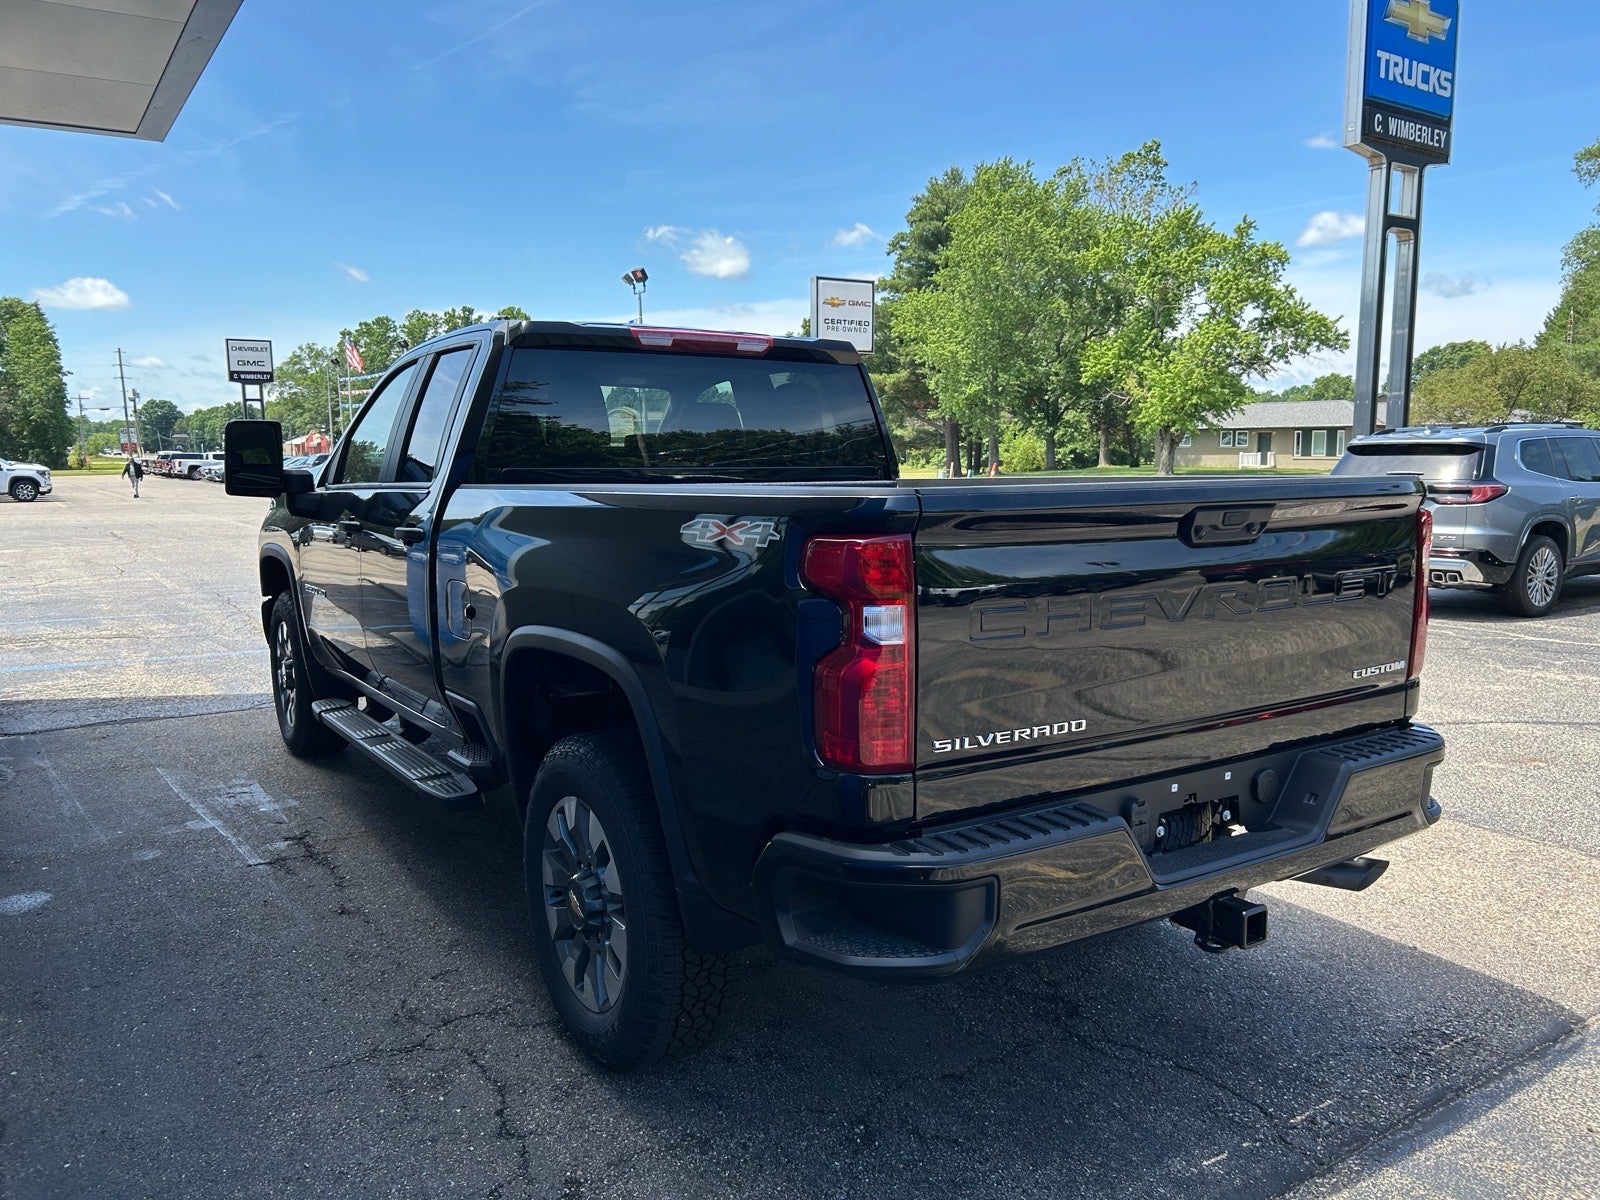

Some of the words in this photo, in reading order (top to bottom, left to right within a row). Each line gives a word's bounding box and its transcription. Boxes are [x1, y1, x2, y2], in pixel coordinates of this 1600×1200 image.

[1376, 49, 1453, 98] TRUCKS
[1374, 113, 1383, 134] C.
[1388, 116, 1447, 149] WIMBERLEY
[823, 318, 870, 326] CERTIFIED
[826, 325, 868, 333] PRE-OWNED
[969, 564, 1398, 642] CHEVROLET
[1352, 660, 1406, 680] CUSTOM
[932, 718, 1087, 754] SILVERADO
